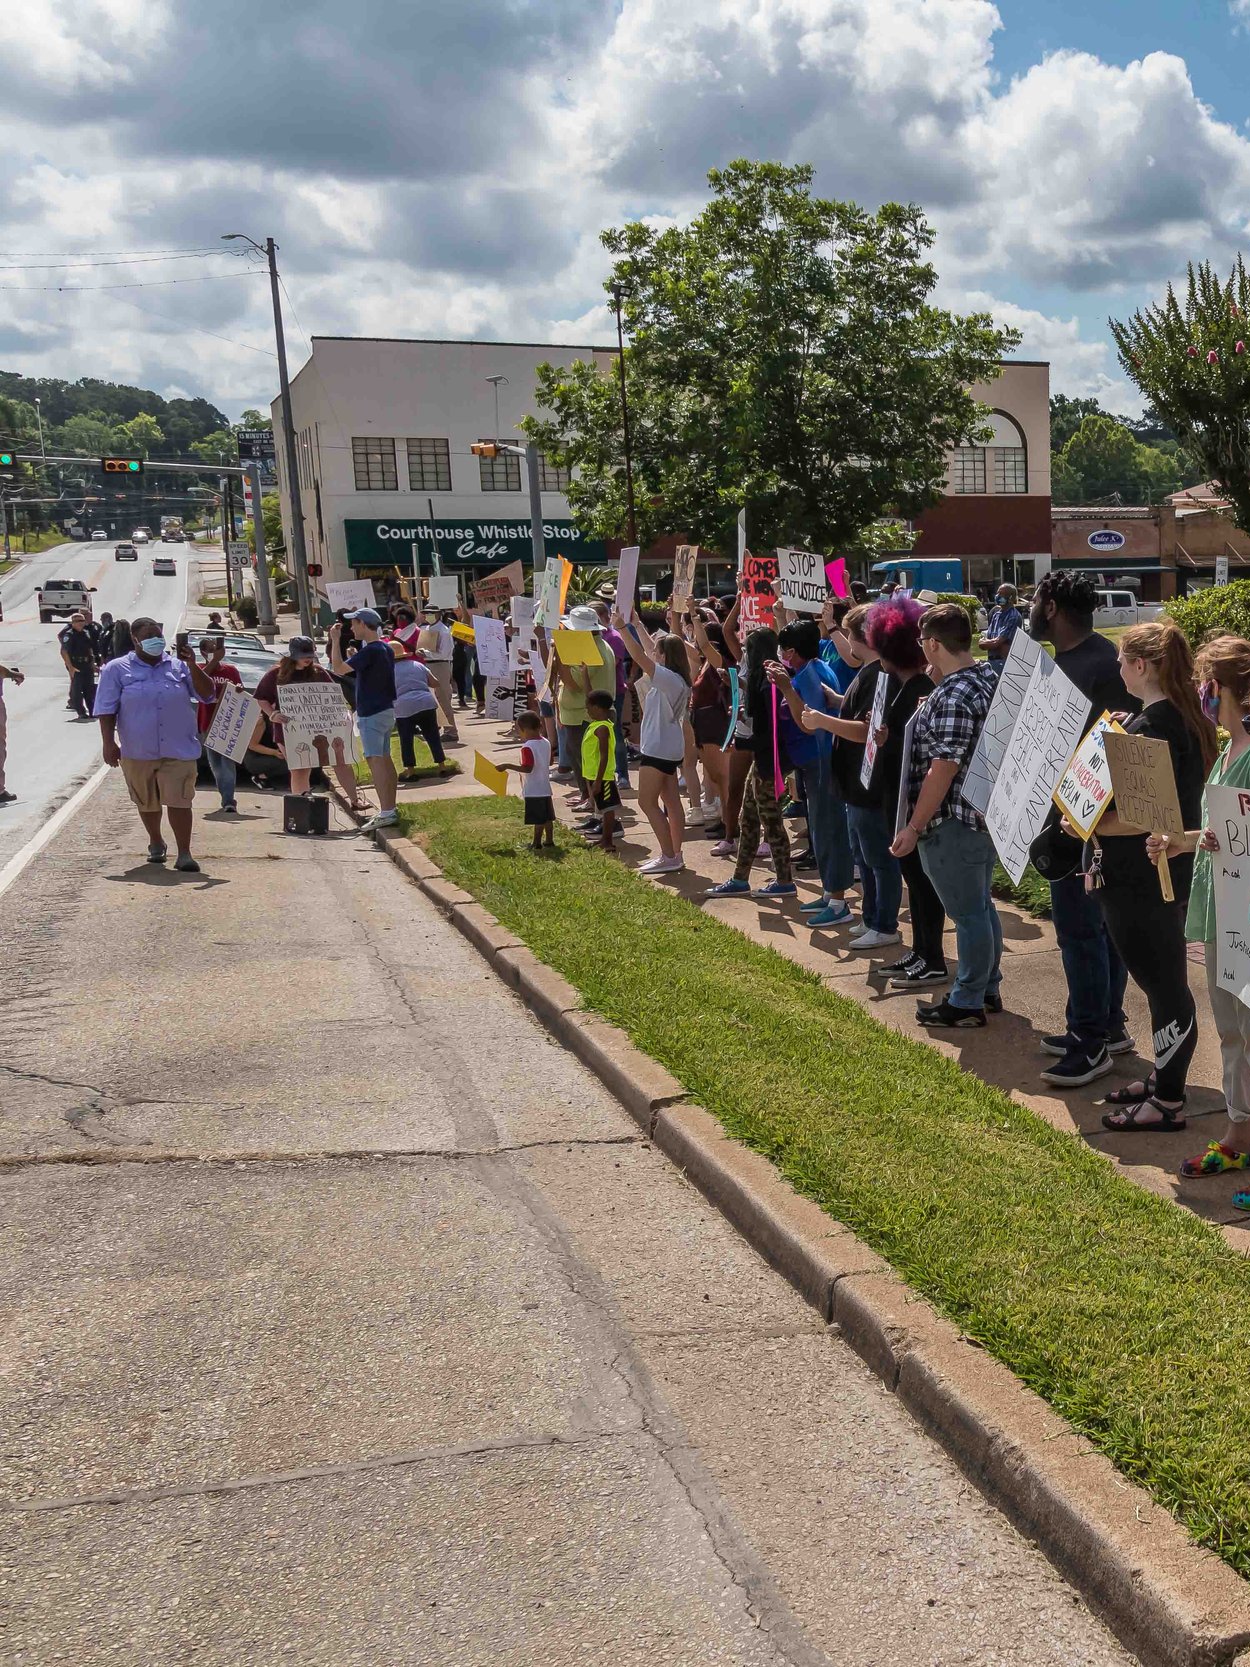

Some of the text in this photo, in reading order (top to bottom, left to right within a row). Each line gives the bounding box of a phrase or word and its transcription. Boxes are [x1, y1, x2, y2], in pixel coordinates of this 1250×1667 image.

[377, 525, 580, 541] Courthouse Whistle Stop
[232, 556, 248, 565] 30
[457, 541, 509, 558] Cafe
[789, 552, 816, 577] STOP
[780, 578, 826, 603] INJUSTICE
[207, 690, 232, 748] ENOUGH IS
[234, 718, 244, 739] LIVES
[961, 632, 1041, 814] EVERYONE
[1023, 696, 1054, 744] RESPECT
[1016, 727, 1039, 775] PEACE
[1088, 752, 1105, 773] NOT
[1115, 738, 1156, 768] SILENCE
[1060, 776, 1082, 808] #BLM
[1124, 768, 1157, 798] EQUALS
[1118, 793, 1180, 834] ACCEPTANCE
